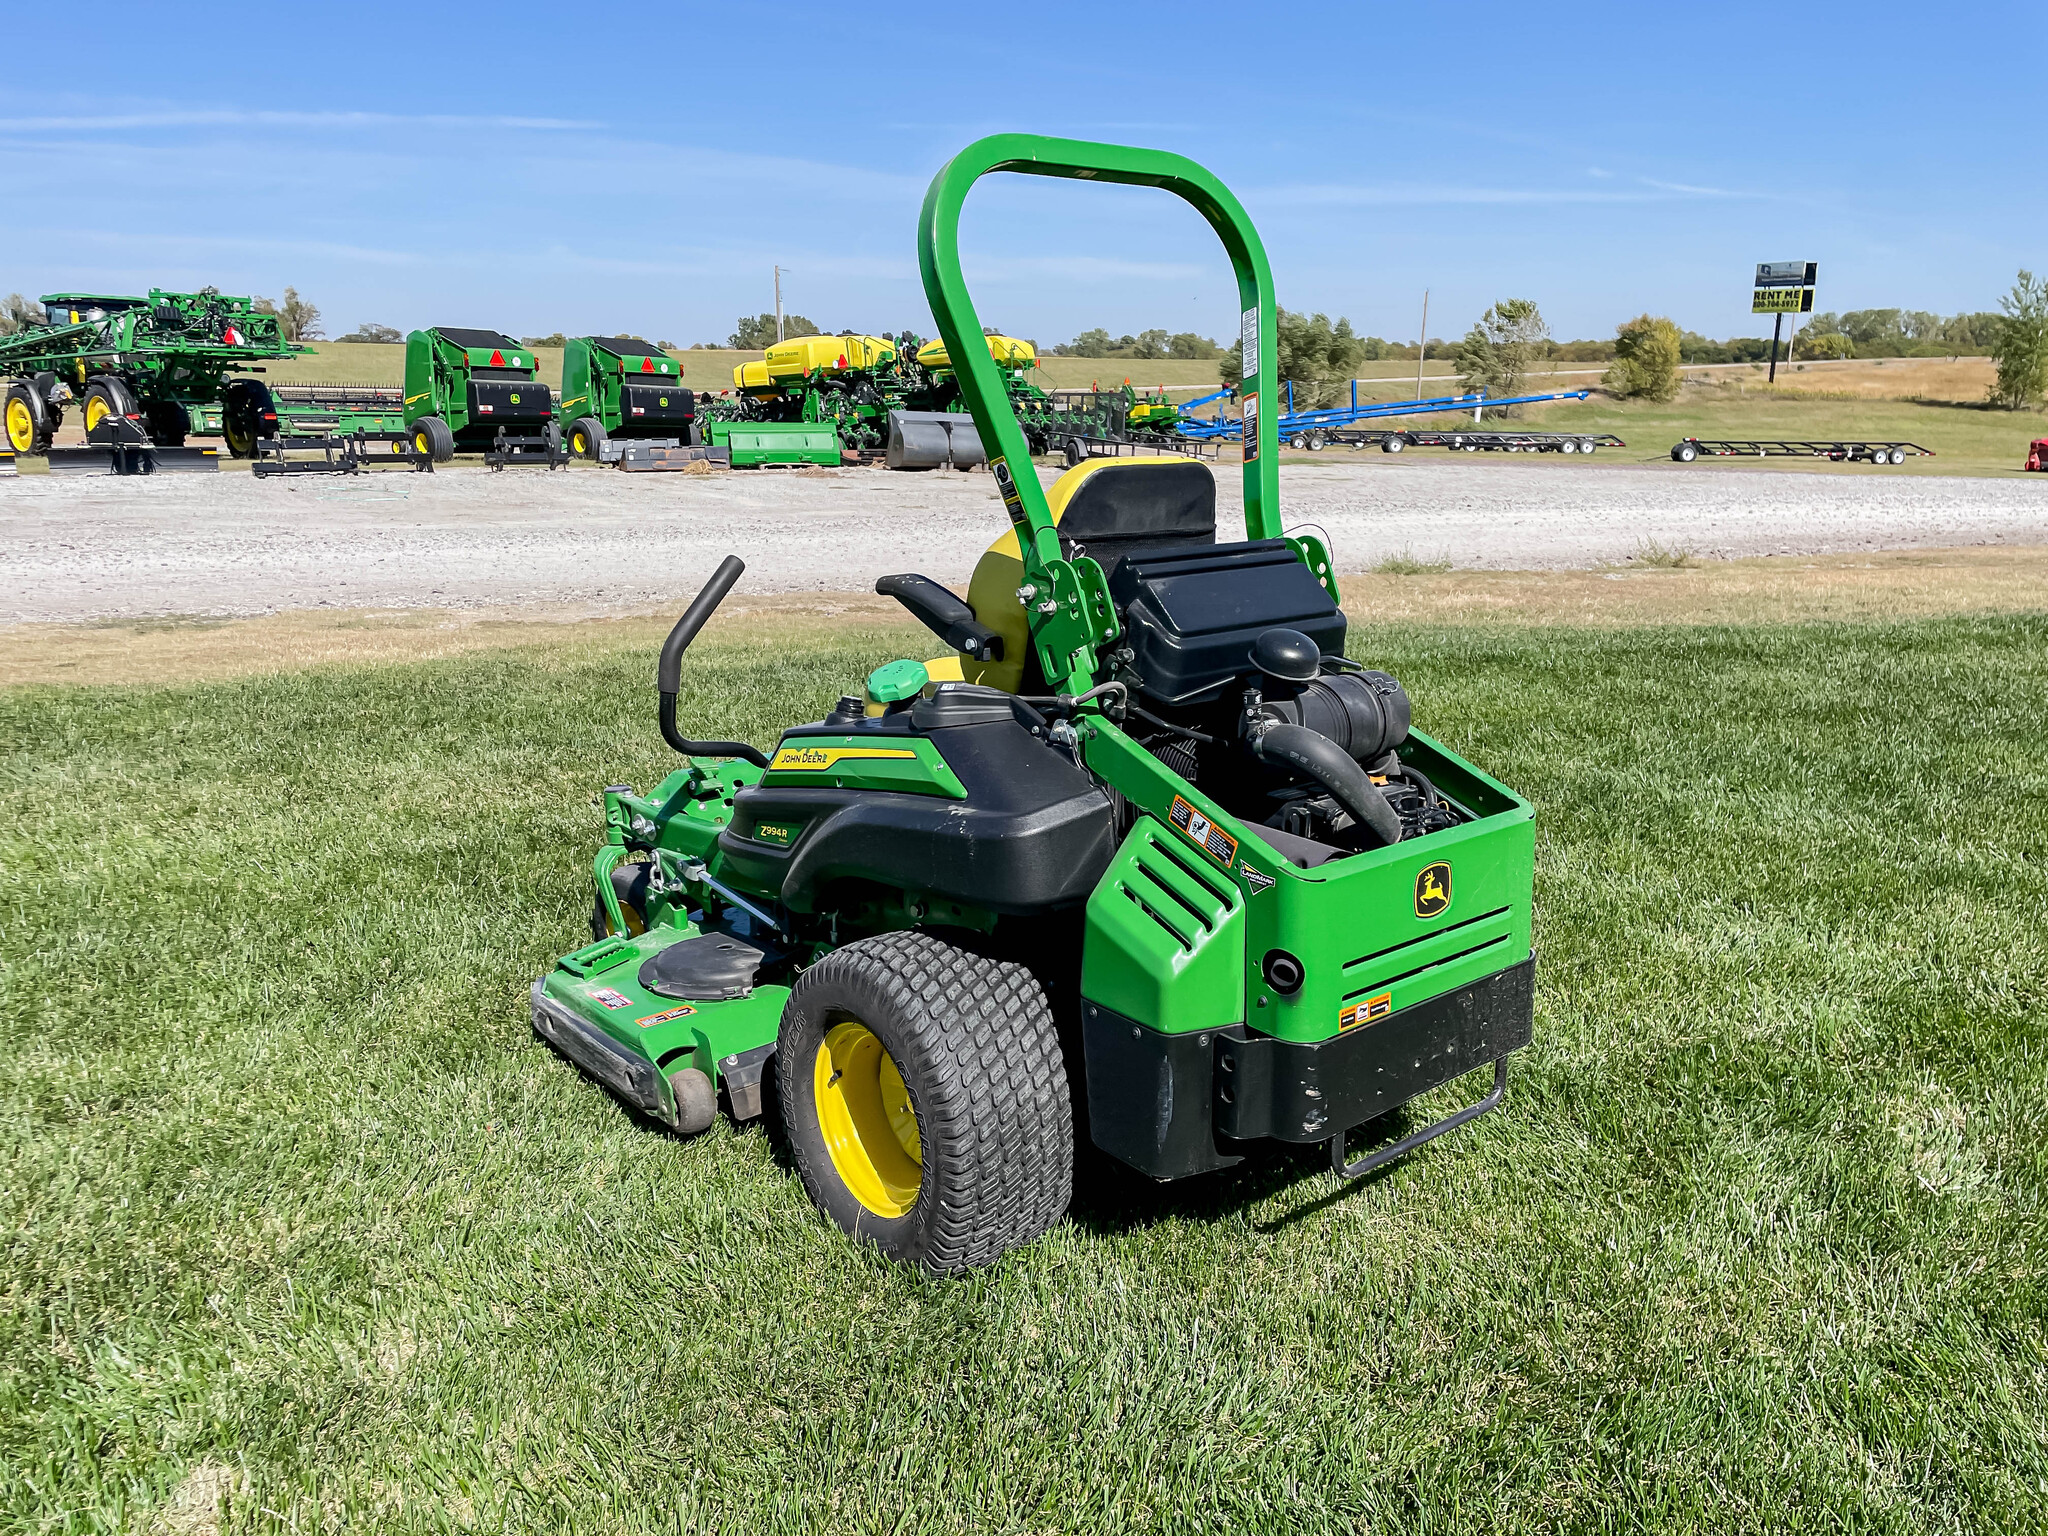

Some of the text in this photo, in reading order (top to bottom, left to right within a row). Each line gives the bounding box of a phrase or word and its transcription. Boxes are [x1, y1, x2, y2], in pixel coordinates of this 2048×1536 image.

[1754, 290, 1800, 300] RENT ME
[781, 753, 801, 763] JOHN
[760, 825, 788, 838] Z994R
[781, 1009, 808, 1132] MASTER
